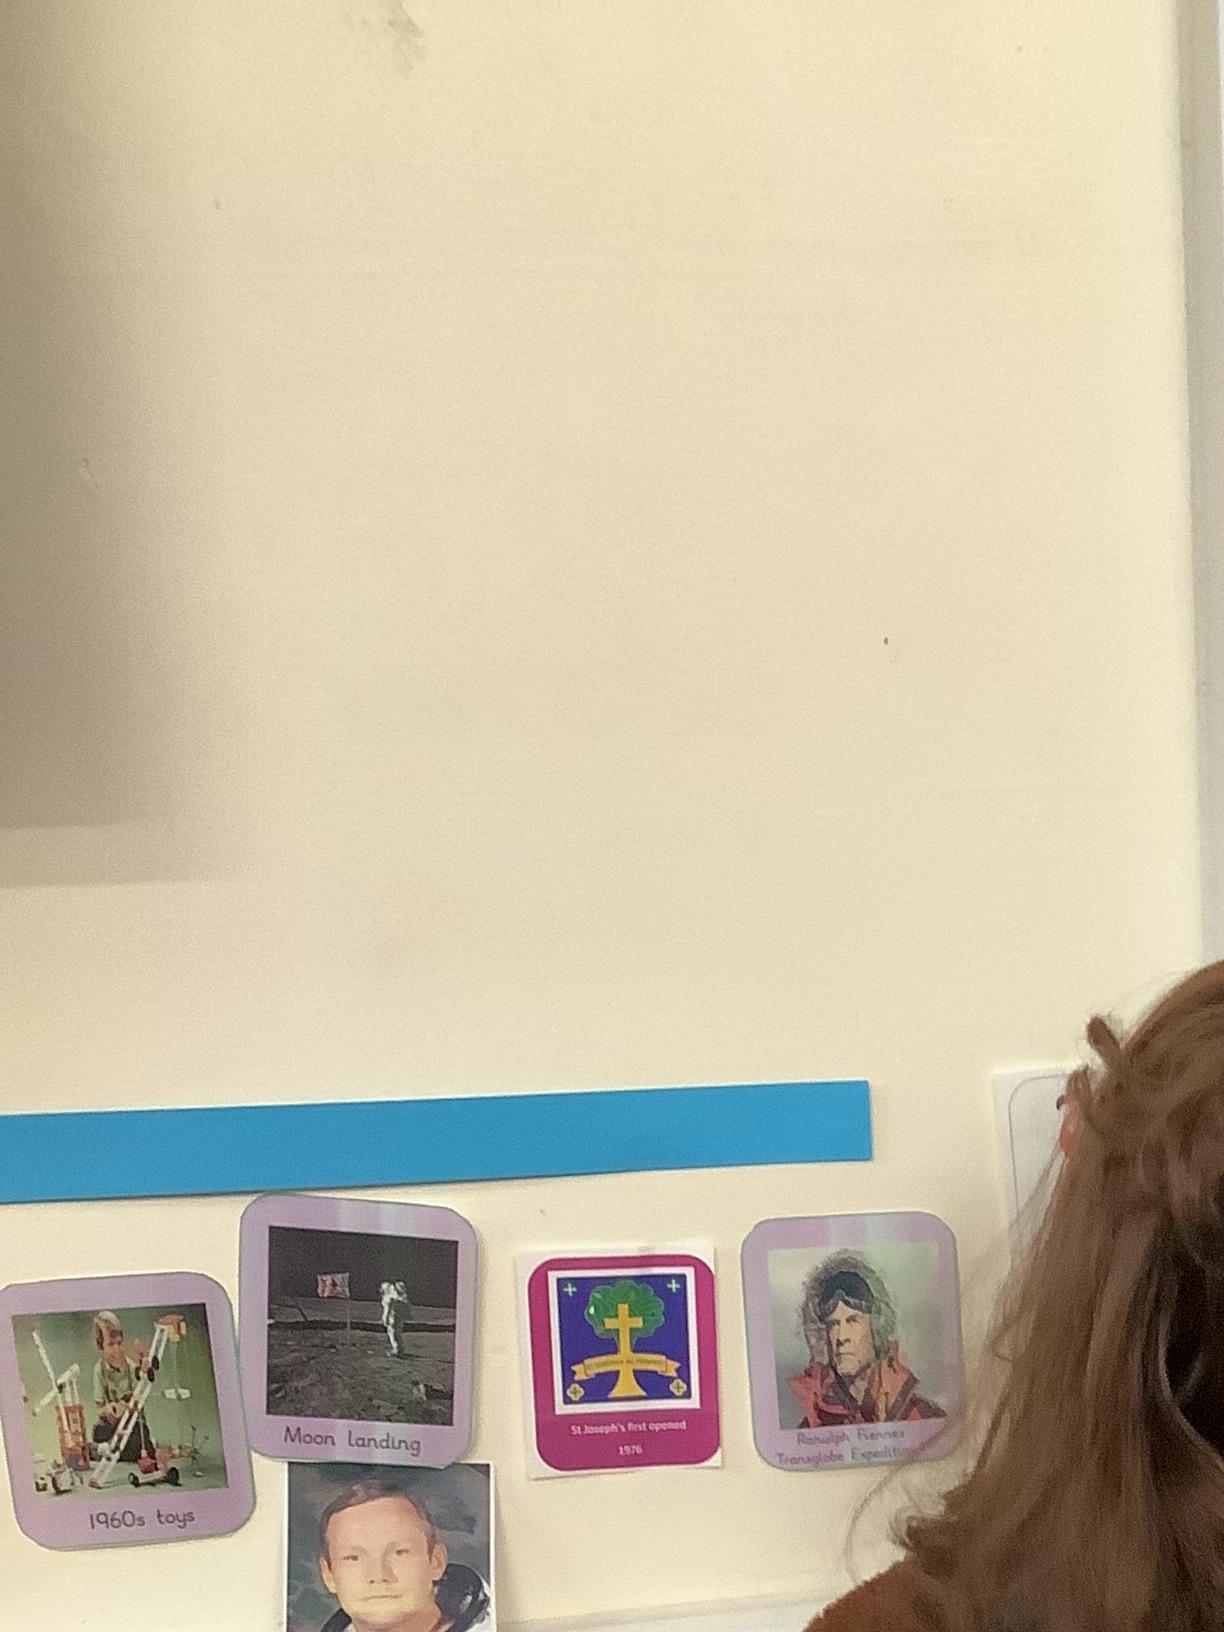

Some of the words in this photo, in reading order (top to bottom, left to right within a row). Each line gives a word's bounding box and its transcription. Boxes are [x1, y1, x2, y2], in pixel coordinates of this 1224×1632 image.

[627, 1421, 647, 1431] first
[648, 1420, 687, 1432] opened
[283, 1426, 336, 1447] Moon
[347, 1430, 421, 1456] landing
[618, 1444, 643, 1456] 1976
[88, 1513, 146, 1531] 1960s
[156, 1507, 195, 1530] toys
